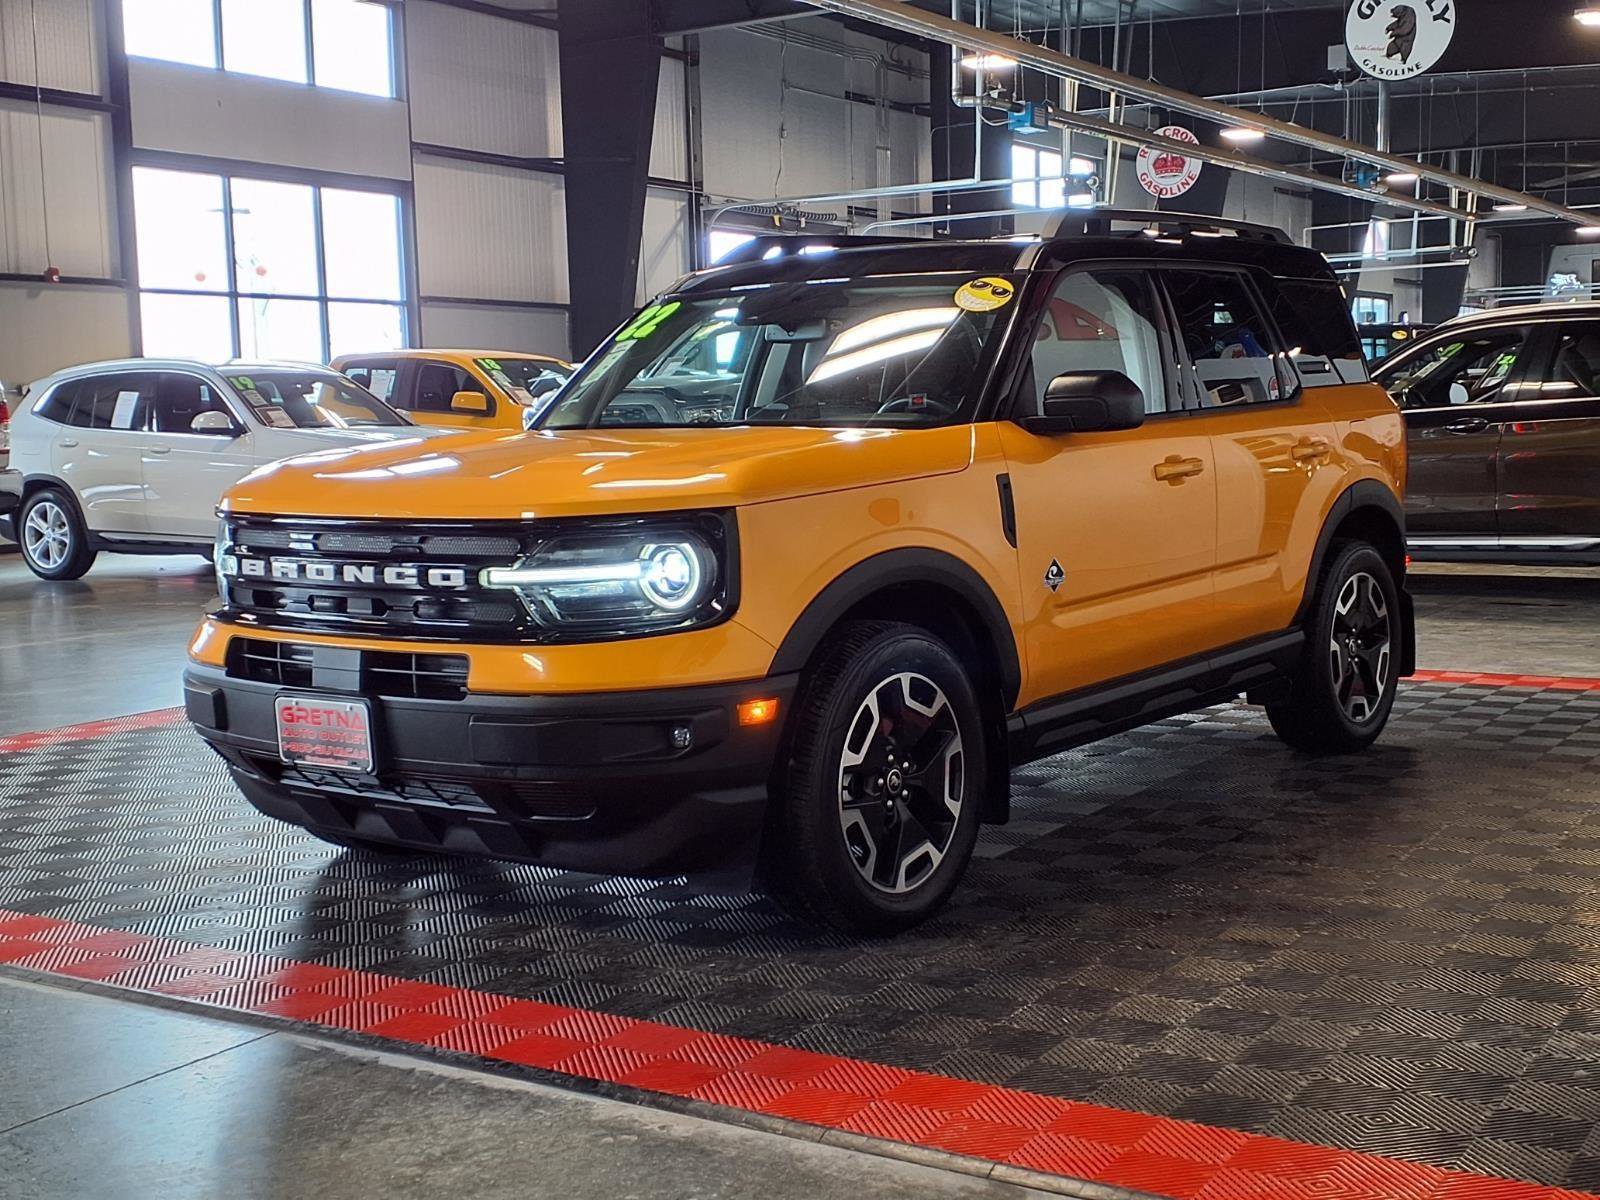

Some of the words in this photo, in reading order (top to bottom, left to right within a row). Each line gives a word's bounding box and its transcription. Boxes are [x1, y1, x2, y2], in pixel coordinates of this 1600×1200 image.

[1362, 58, 1423, 77] GASOLINE
[1140, 171, 1197, 197] GASOLINE
[228, 376, 256, 391] 19
[241, 558, 466, 588] BRONCO
[281, 705, 366, 731] GRETNA
